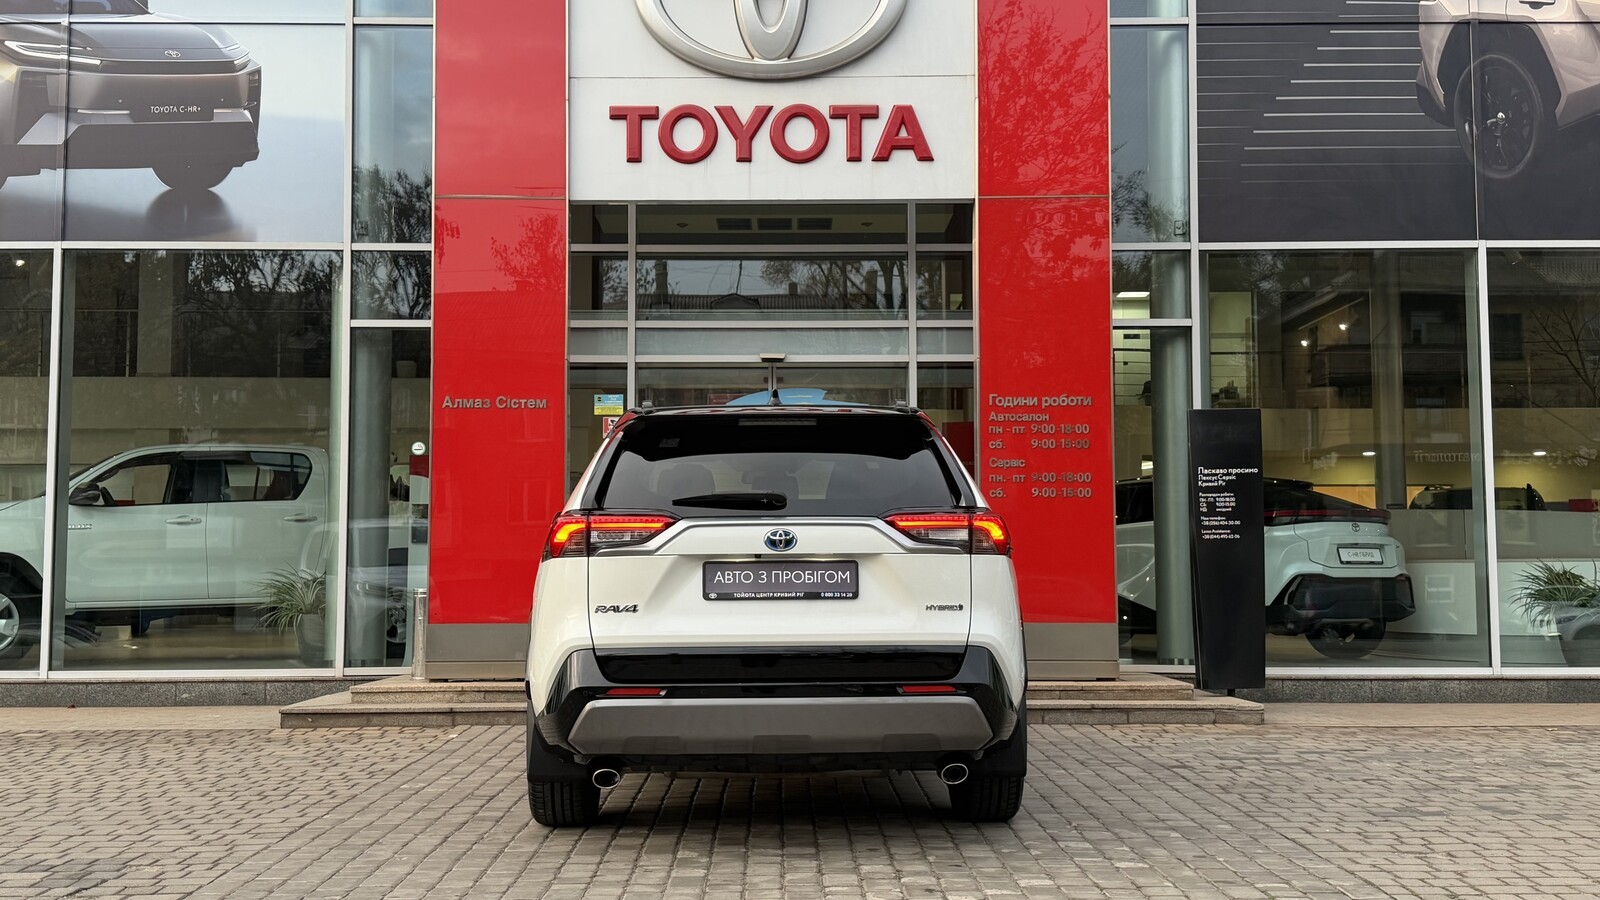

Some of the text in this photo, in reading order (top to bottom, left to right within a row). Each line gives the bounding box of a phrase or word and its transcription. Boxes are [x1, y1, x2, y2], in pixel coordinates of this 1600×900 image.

[150, 105, 178, 113] TOYOTA
[609, 103, 934, 164] TOYOTA
[442, 395, 547, 409] Алмаз Сістем
[988, 393, 1092, 409] Години роботи
[988, 411, 1050, 421] Автосалон
[988, 439, 1006, 449] сб.
[989, 457, 1026, 469] Сервіс
[989, 488, 1007, 498] сб.
[713, 570, 851, 584] АВТО З ПРОБІГОМ
[594, 604, 639, 614] RAV4
